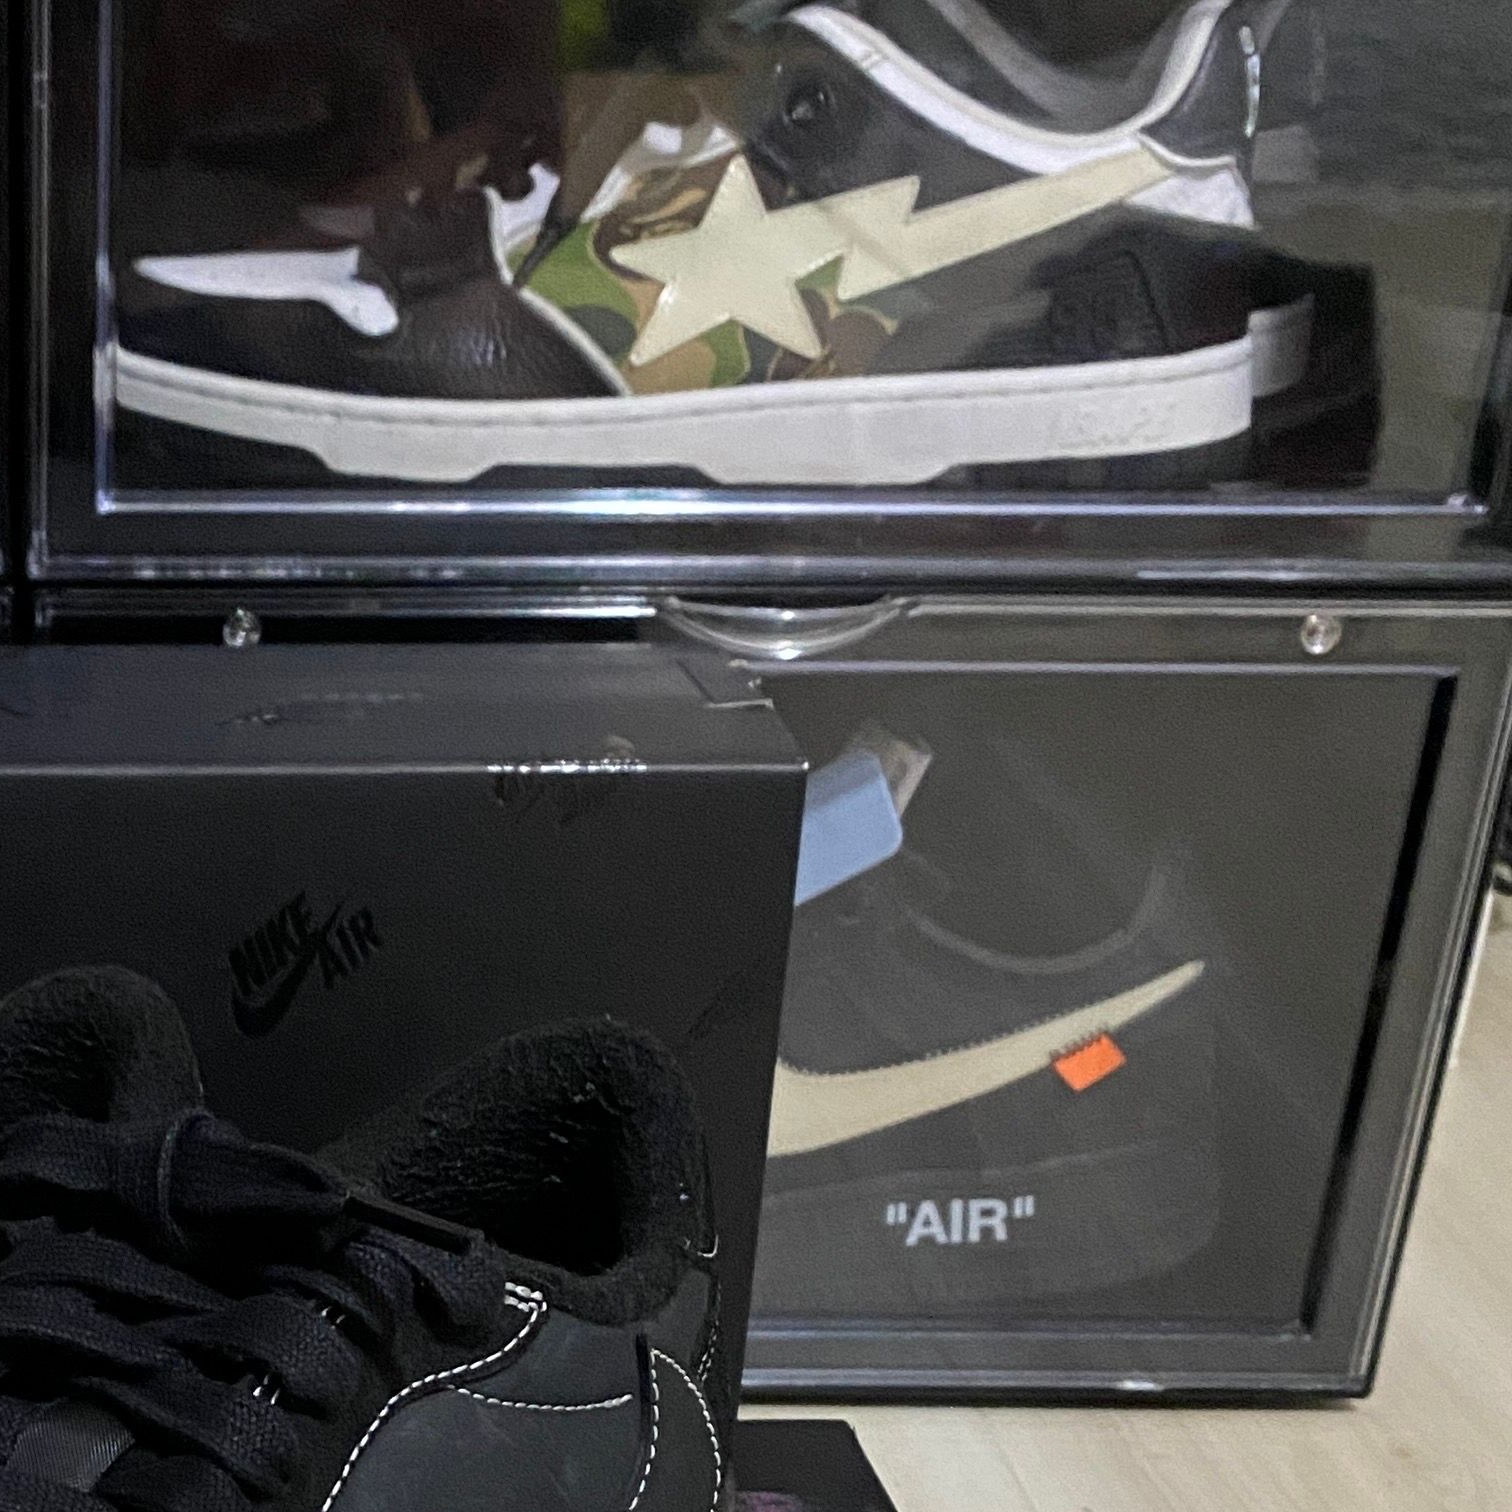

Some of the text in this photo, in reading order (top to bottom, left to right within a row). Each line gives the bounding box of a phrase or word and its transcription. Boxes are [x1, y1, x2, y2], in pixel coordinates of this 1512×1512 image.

[229, 891, 383, 996] NIKE AIR
[886, 1195, 1035, 1246] "AIR"
